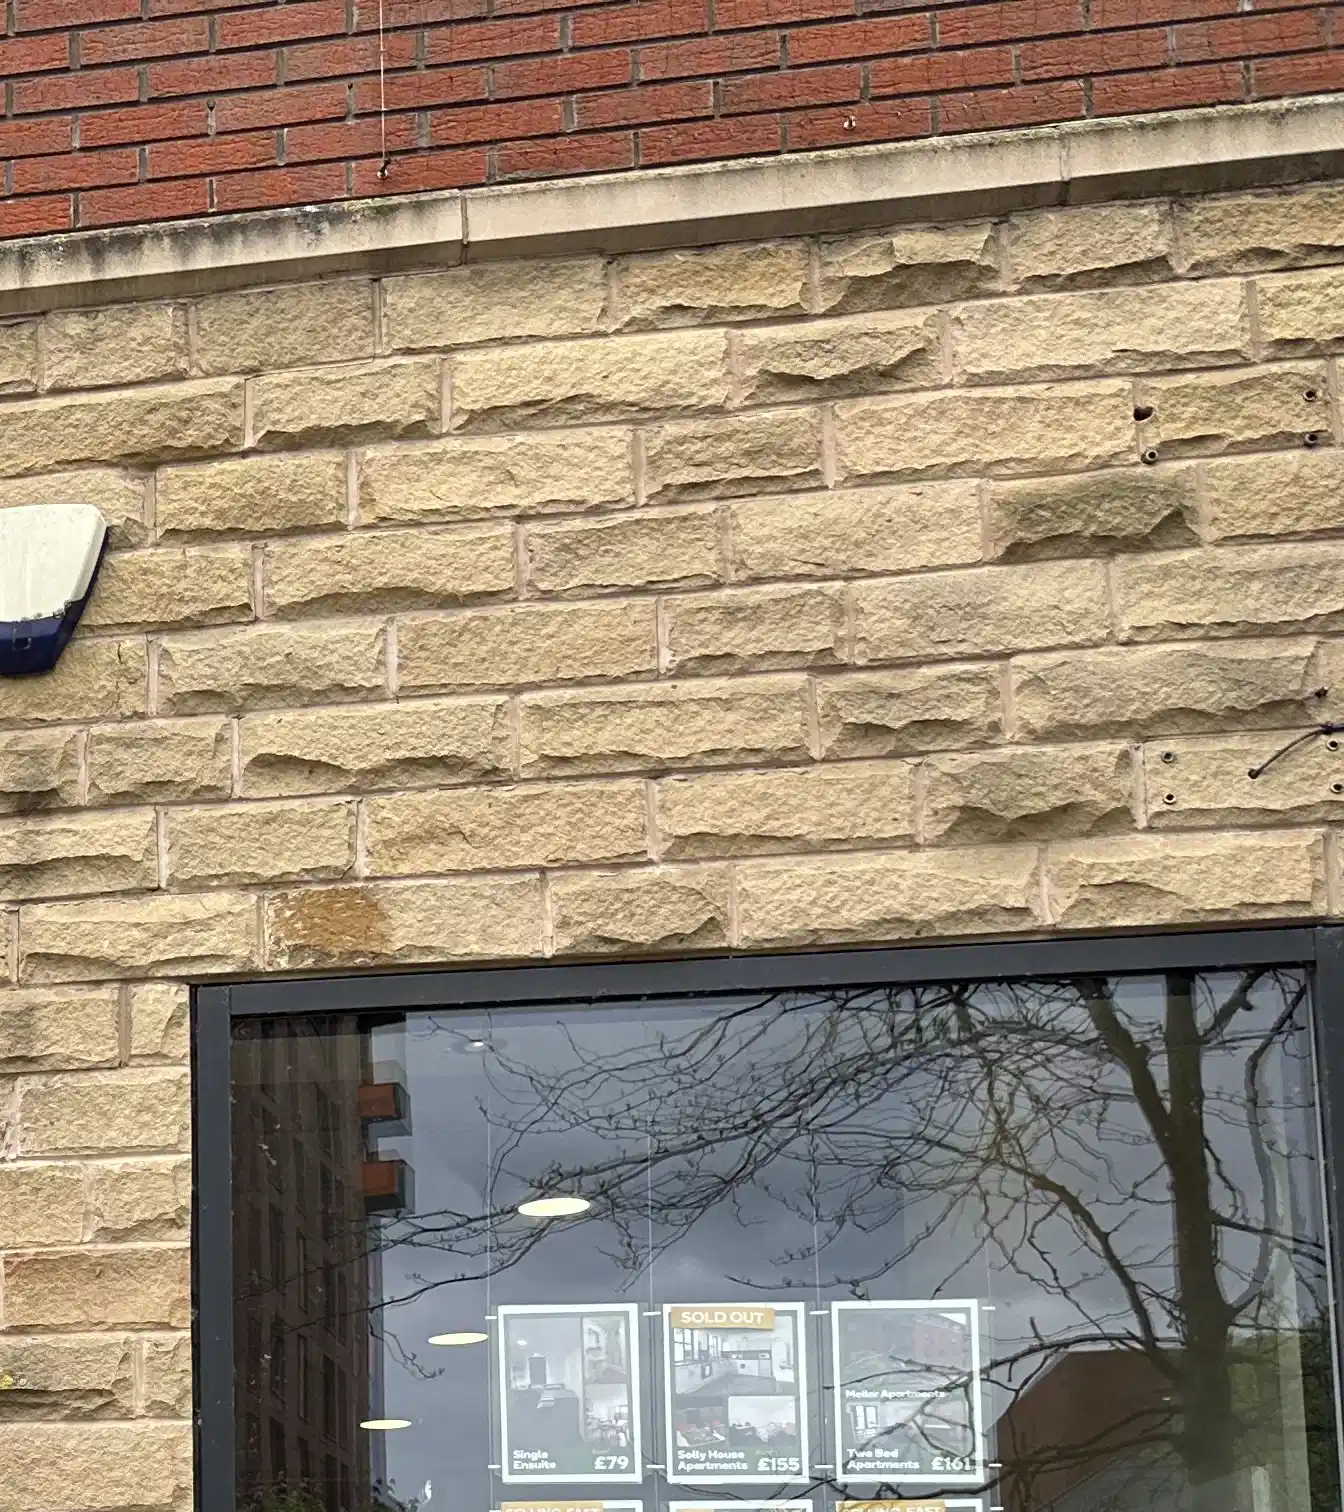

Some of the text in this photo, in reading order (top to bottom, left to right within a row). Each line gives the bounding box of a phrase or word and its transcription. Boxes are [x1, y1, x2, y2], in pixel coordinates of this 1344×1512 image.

[681, 1311, 765, 1325] SOLD OUT
[512, 1450, 549, 1461] Single
[677, 1450, 707, 1461] Solly
[708, 1450, 745, 1460] House
[847, 1448, 898, 1458] Two Bed
[513, 1460, 556, 1470] Ensuite
[594, 1455, 629, 1470] £79
[677, 1460, 748, 1472] Apartments
[757, 1457, 800, 1472] £155
[847, 1460, 920, 1471] Apartments
